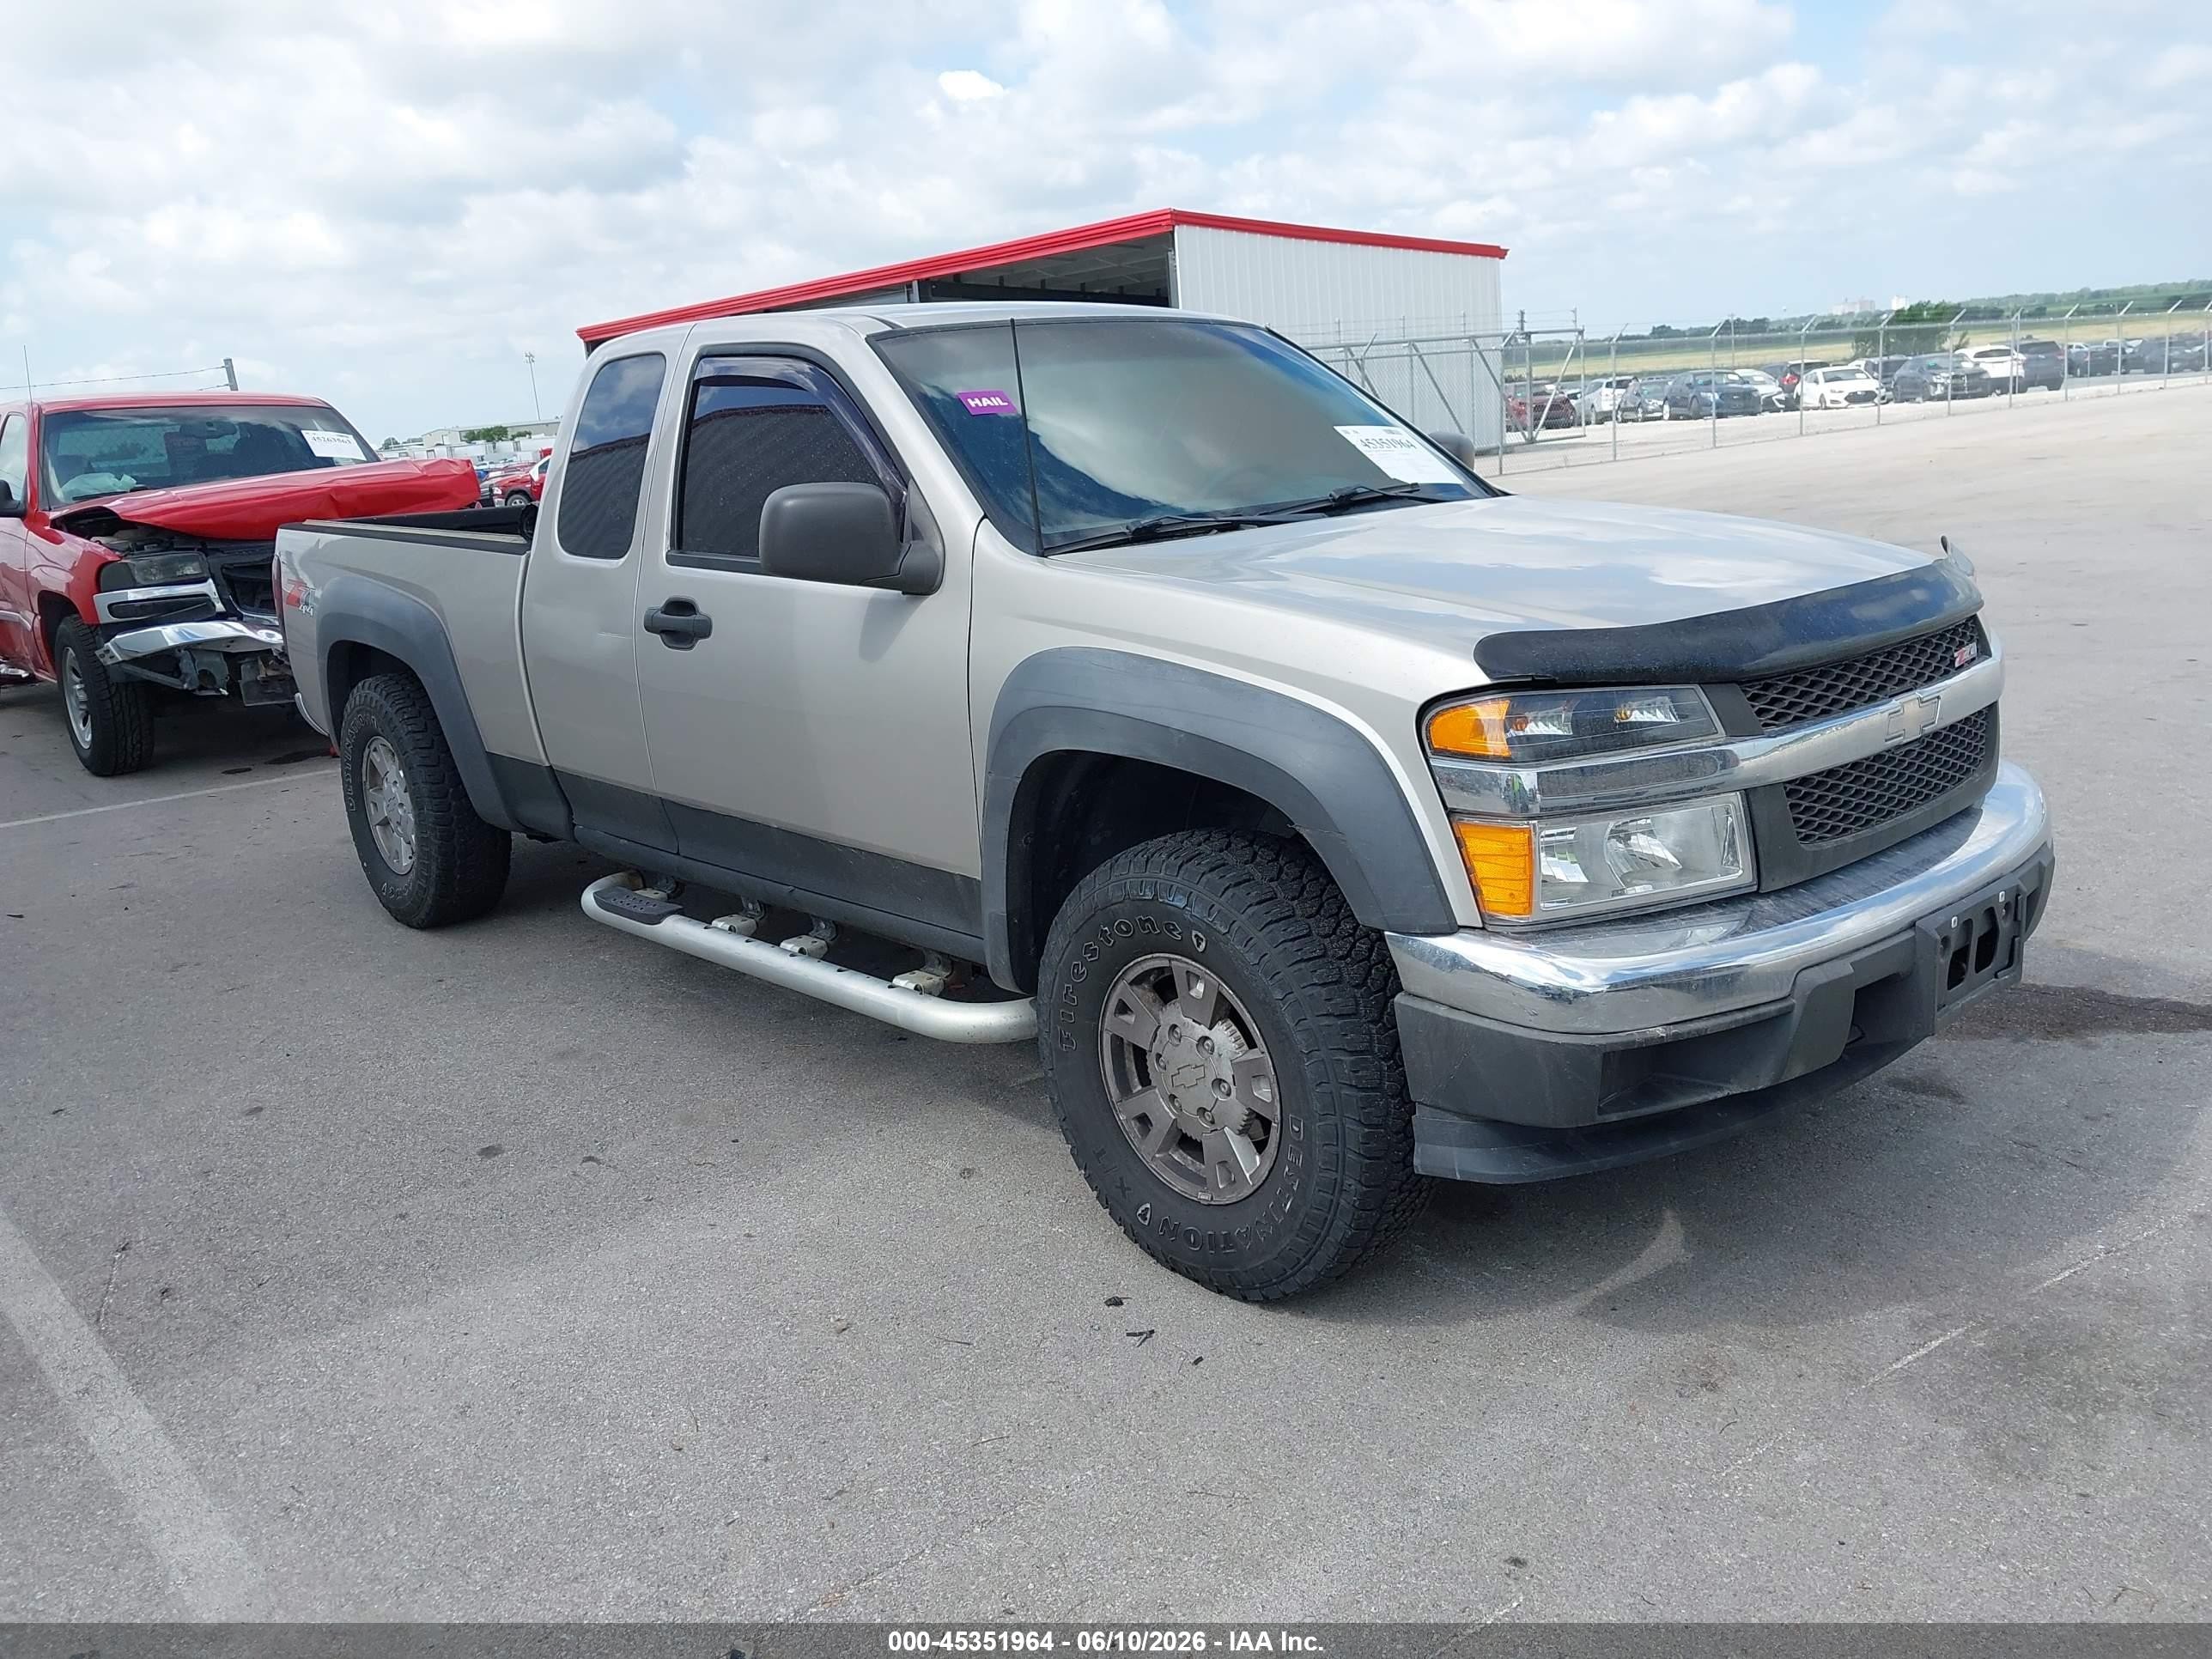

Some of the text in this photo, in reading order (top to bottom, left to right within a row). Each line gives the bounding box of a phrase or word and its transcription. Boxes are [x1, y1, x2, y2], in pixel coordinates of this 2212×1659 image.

[967, 397, 1009, 408] HAIL
[1359, 438, 1417, 449] 45351964
[1057, 915, 1182, 1052] Firestone
[1158, 1114, 1305, 1254] DESTINATION
